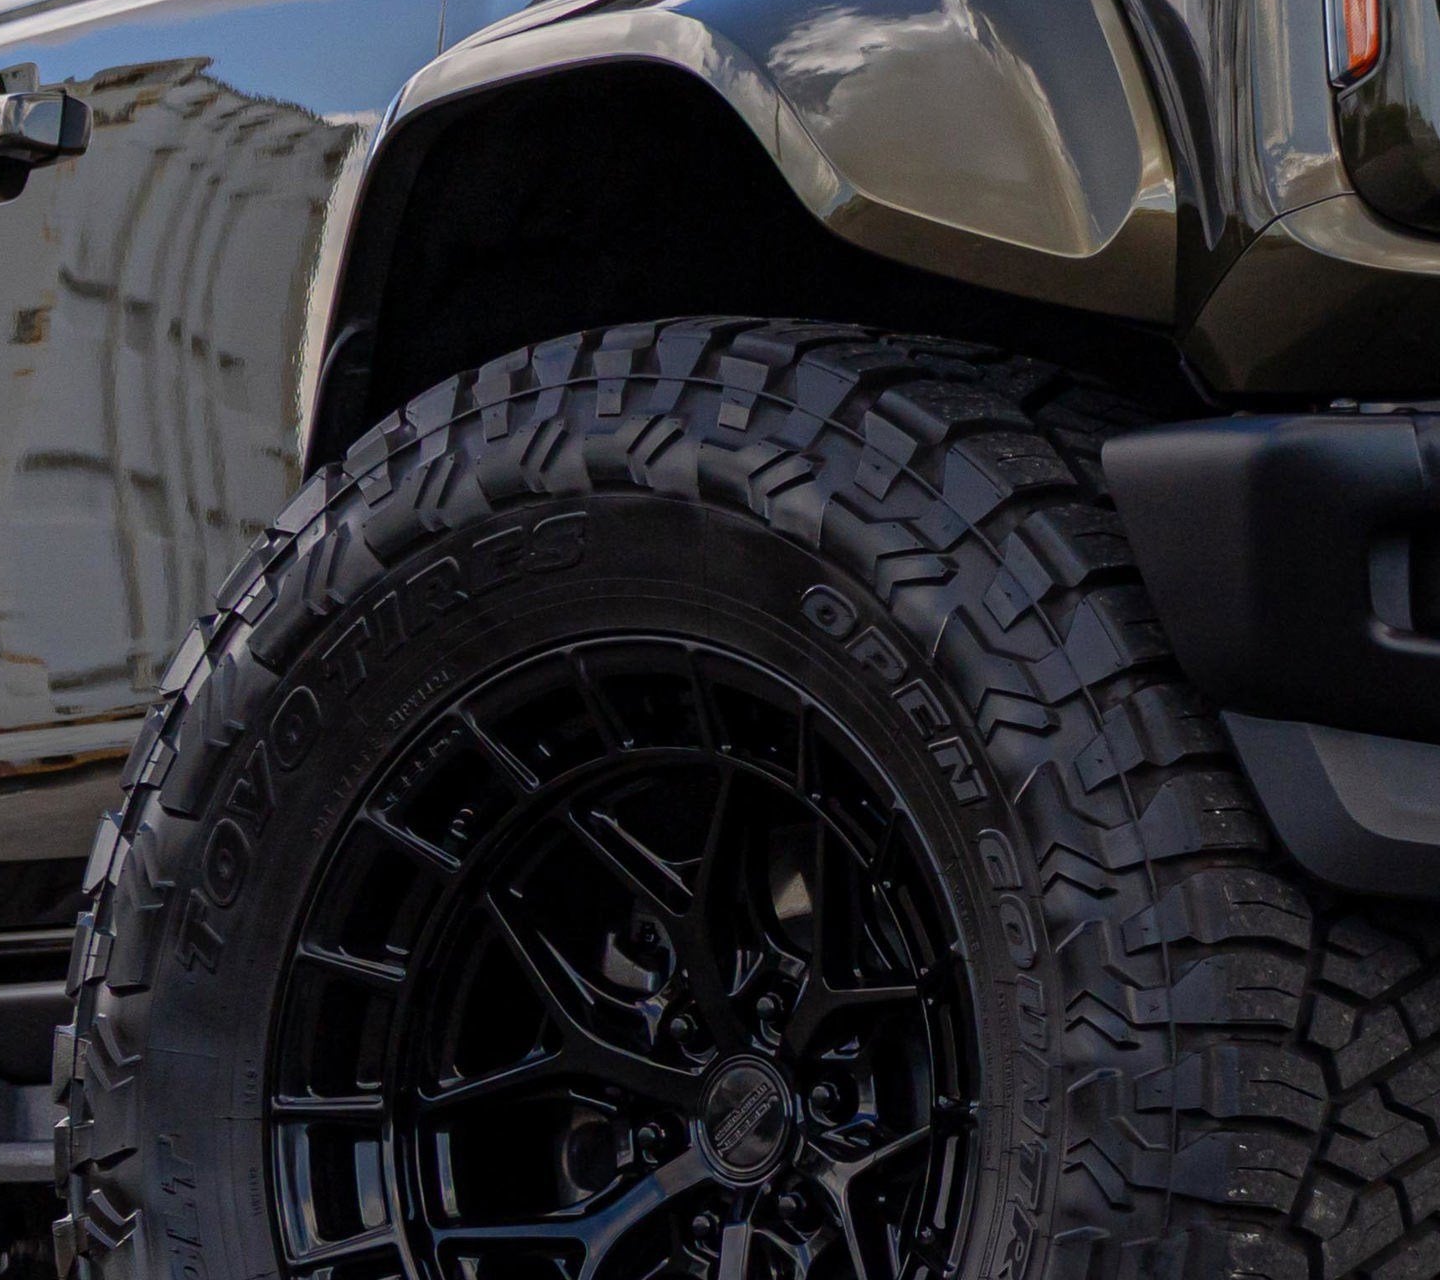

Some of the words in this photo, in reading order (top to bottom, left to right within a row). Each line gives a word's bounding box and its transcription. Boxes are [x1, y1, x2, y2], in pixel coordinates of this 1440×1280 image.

[174, 683, 327, 976] TOYO
[320, 510, 589, 702] TIRES
[798, 583, 990, 807] OPEN
